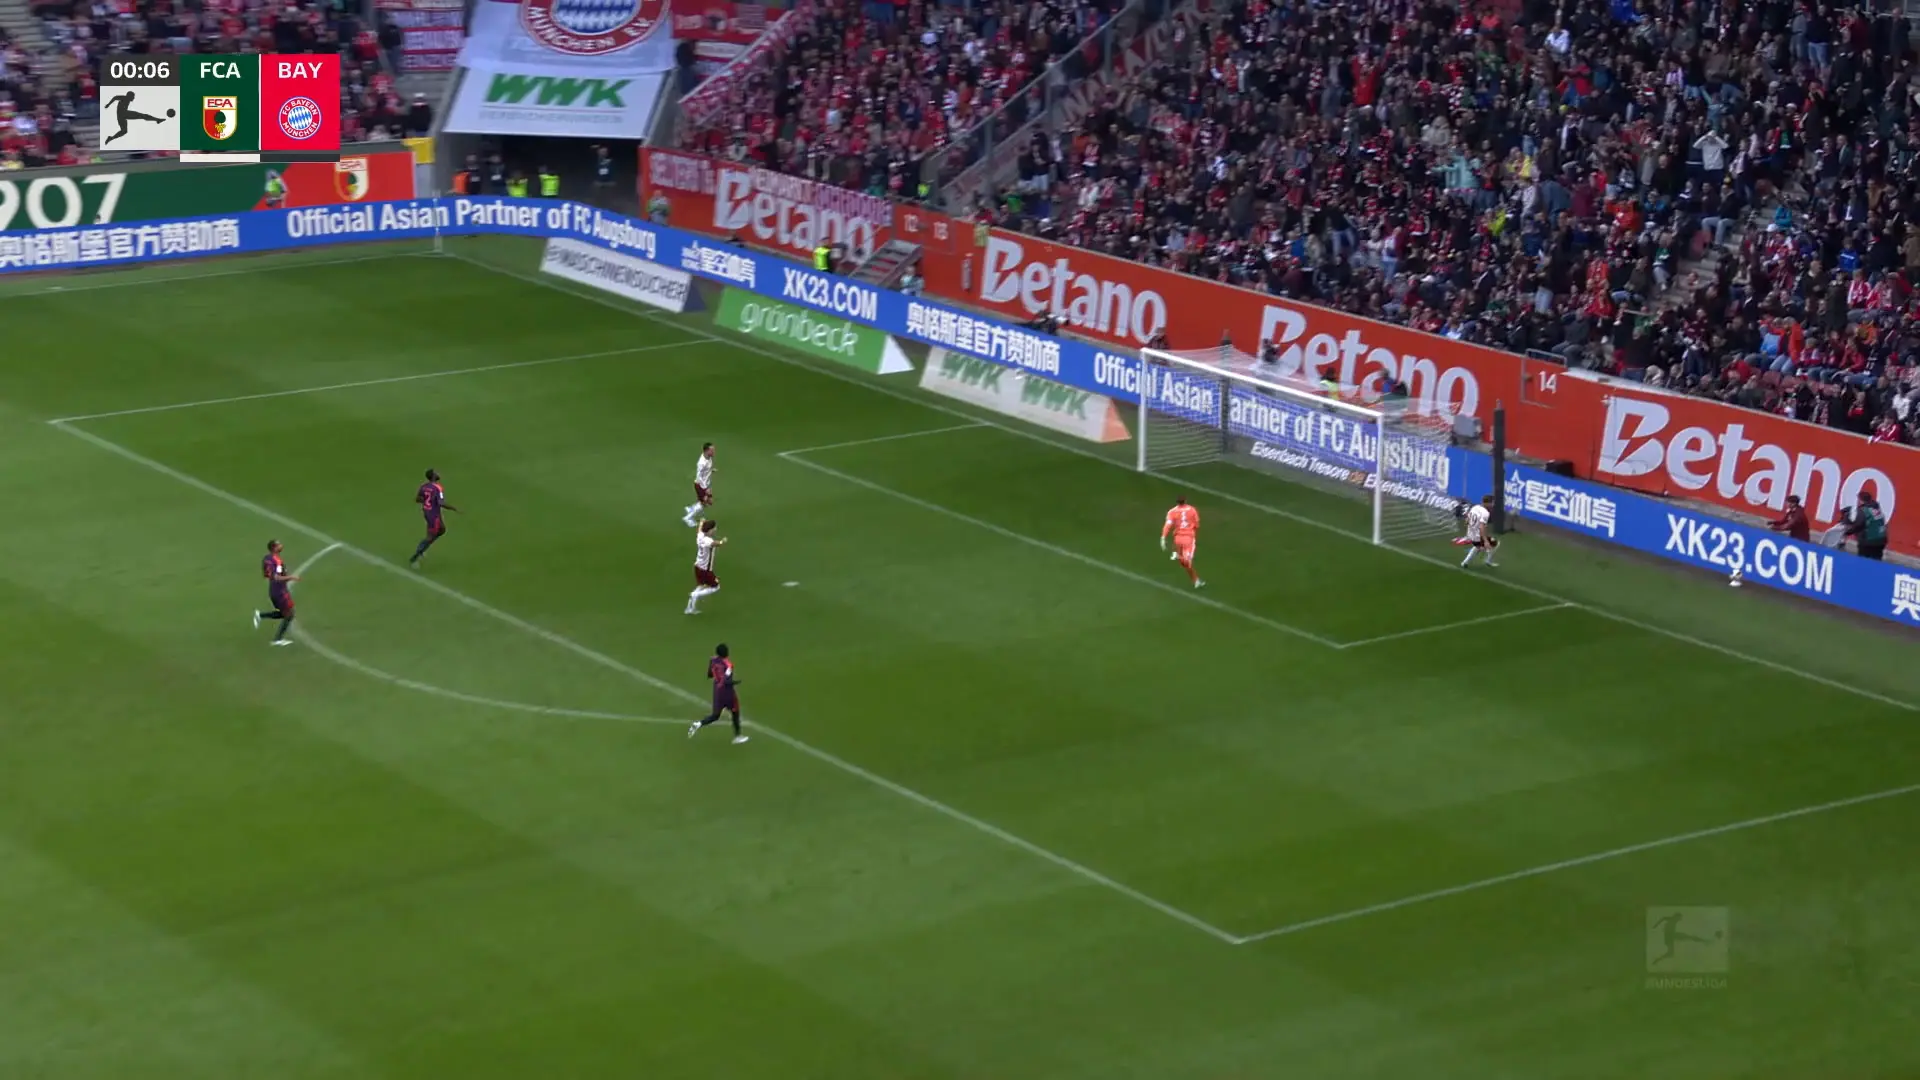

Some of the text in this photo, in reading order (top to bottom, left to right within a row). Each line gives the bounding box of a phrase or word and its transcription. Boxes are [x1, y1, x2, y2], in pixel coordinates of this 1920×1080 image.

[484, 73, 633, 108] WWK
[287, 205, 375, 239] Official
[379, 201, 450, 232] Asian
[455, 198, 541, 228] Partner
[546, 202, 571, 229] of
[573, 205, 592, 235] FC
[593, 210, 657, 260] Augsburg
[713, 167, 874, 264] Betano
[783, 266, 879, 322] XK23.COM
[980, 235, 1167, 345] Betano
[737, 302, 859, 357] grünbeck
[906, 301, 1061, 377] 奥格斯堡官方赞助商
[938, 350, 1006, 394] WWK
[1256, 304, 1480, 425] Betano
[1538, 370, 1557, 394] 14
[1019, 371, 1093, 421] WWK
[1160, 371, 1213, 416] Asian
[1230, 395, 1290, 438] artner
[1293, 410, 1315, 443] of
[1319, 414, 1345, 453] FC
[1349, 418, 1450, 490] Ausburg
[1598, 395, 1896, 526] Betano
[1364, 473, 1425, 502] Eenbach
[1524, 479, 1617, 539] 星空体育
[1665, 512, 1834, 595] XK23.COM
